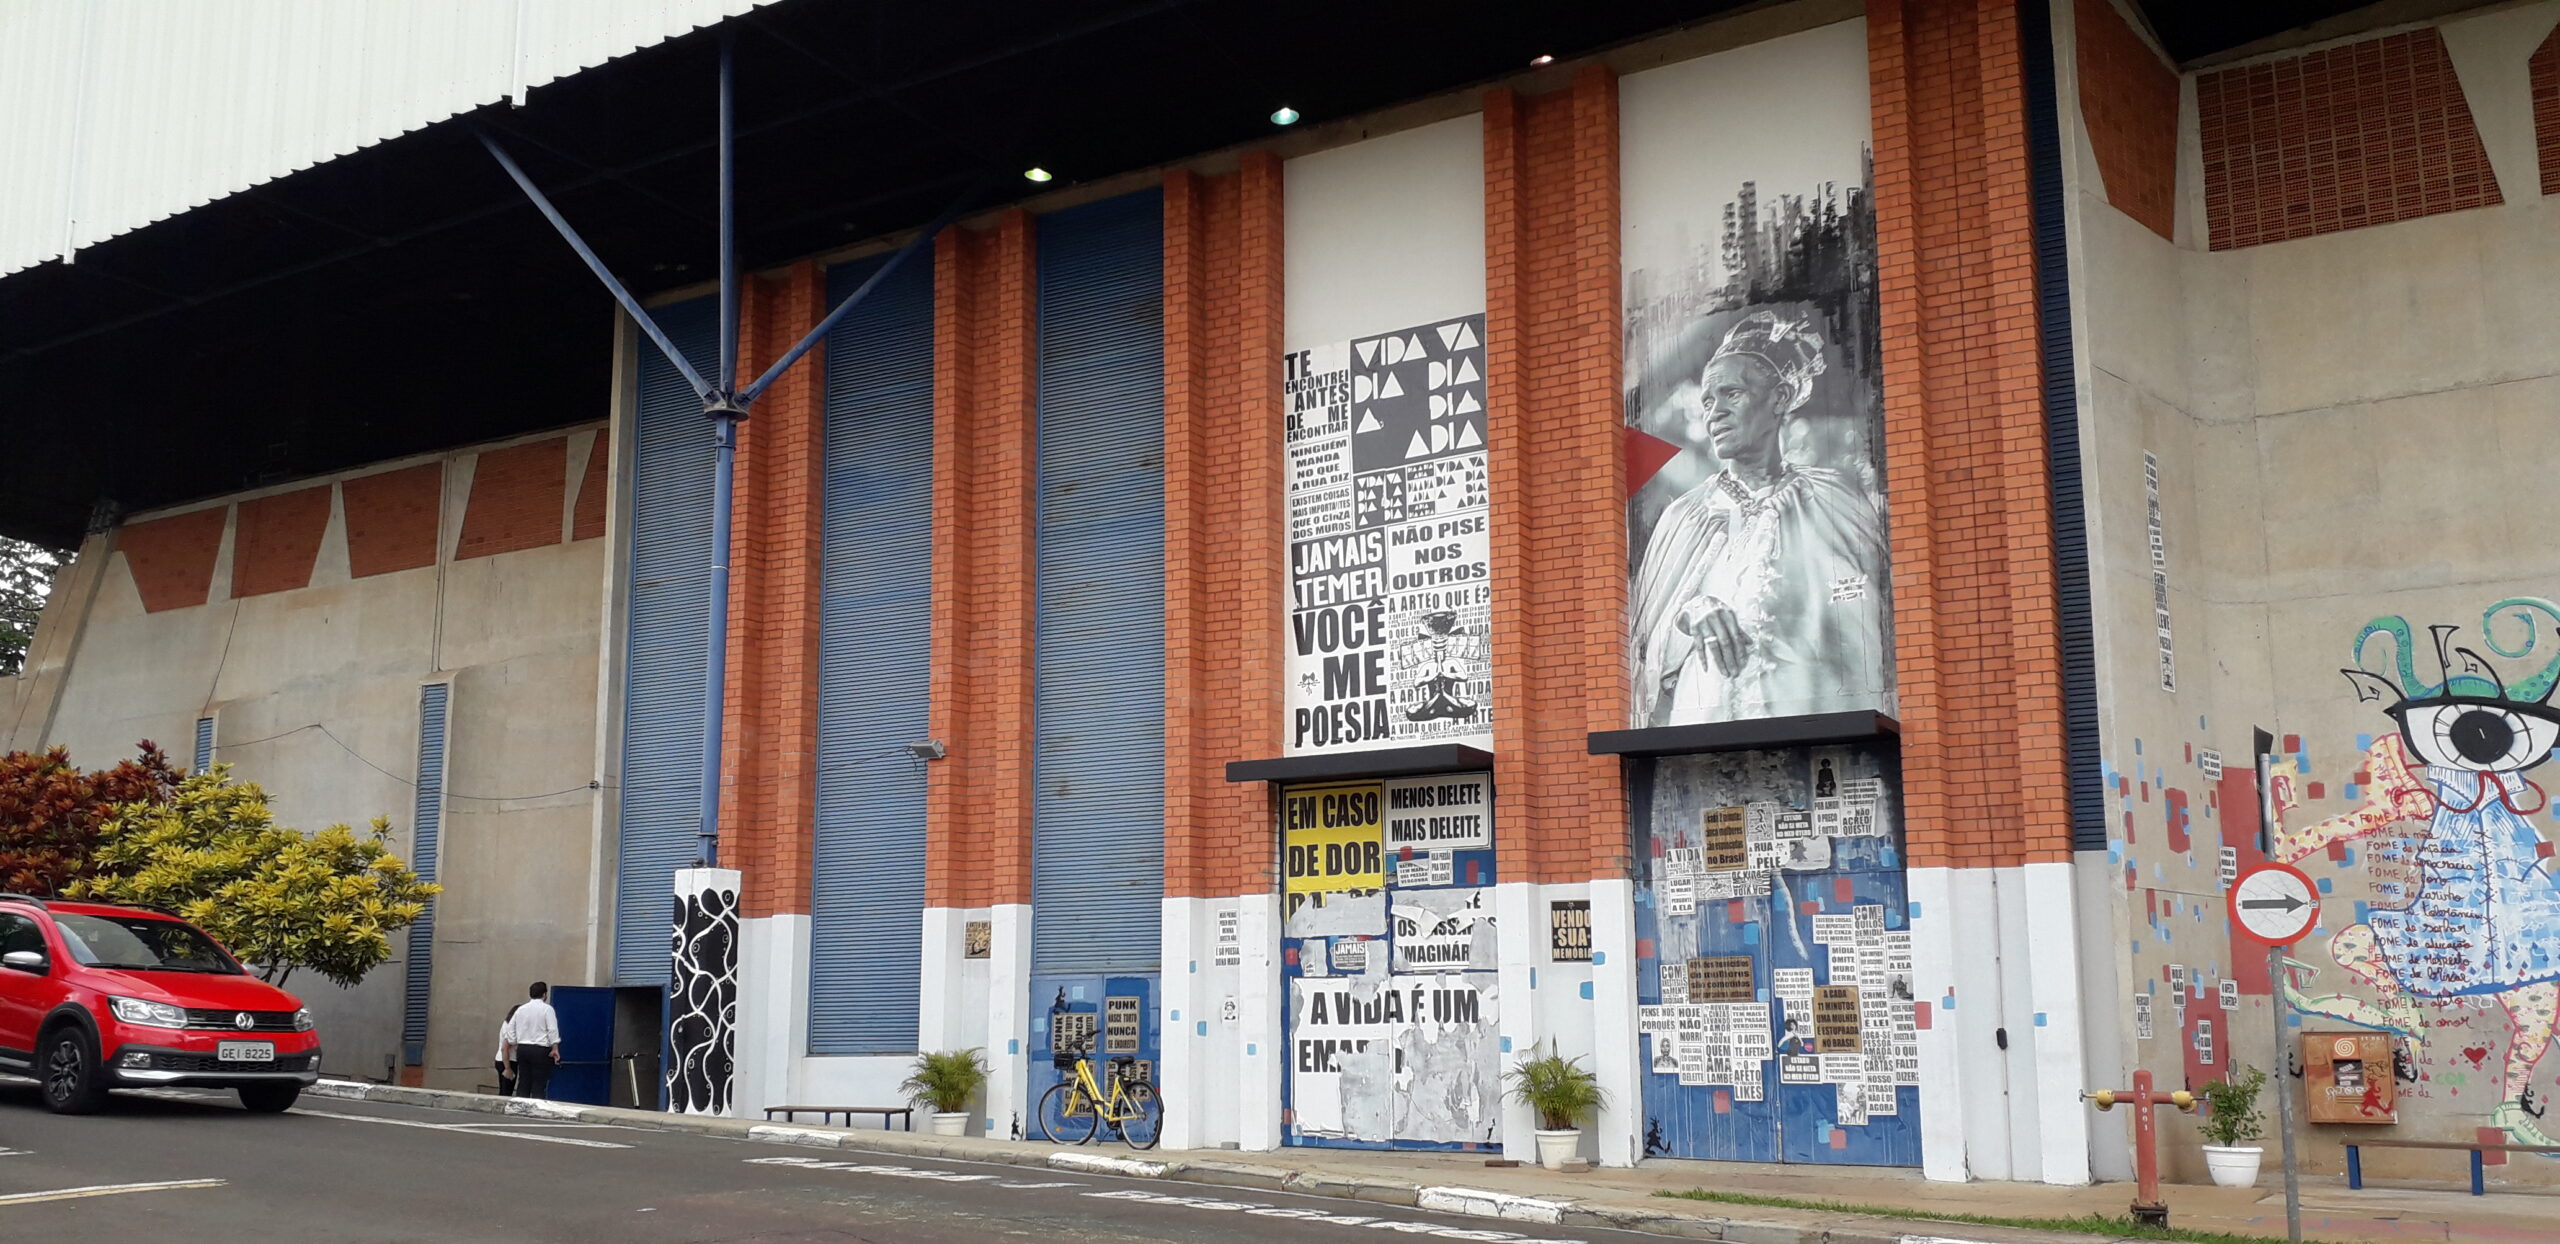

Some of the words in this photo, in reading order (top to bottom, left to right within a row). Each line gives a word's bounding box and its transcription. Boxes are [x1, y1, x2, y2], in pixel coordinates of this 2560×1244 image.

[1355, 333, 1427, 368] VIDA
[1285, 349, 1311, 381] TE
[1285, 369, 1348, 394] ENCONTREI
[1354, 371, 1405, 404] DIA
[1428, 355, 1481, 391] DIA
[1295, 382, 1349, 412] ANTES
[1429, 389, 1482, 420] DIA
[1287, 412, 1304, 431] DE
[1328, 403, 1348, 423] ME
[1287, 421, 1348, 443] ENCONTRAR
[1291, 439, 1347, 458] NINGUÉM
[1296, 452, 1340, 468] MANDA
[1436, 460, 1464, 472] VIDA
[1297, 469, 1313, 479] NO
[1317, 463, 1340, 475] QUE
[1303, 477, 1327, 489] RUA
[1330, 473, 1349, 483] DIZ
[1357, 475, 1384, 488] VIDA
[1292, 494, 1321, 507] EXISTEM
[1323, 488, 1349, 500] COISAS
[1292, 507, 1308, 518] MAIS
[1293, 517, 1311, 529] QUE
[1293, 528, 1313, 539] DOS
[1316, 521, 1351, 535] MUROS
[1391, 524, 1433, 547] NÃO
[1438, 516, 1485, 539] PISE
[1295, 530, 1383, 576] JAMAIS
[1414, 543, 1462, 565] NOS
[1393, 561, 1487, 591] OUTROS
[1296, 566, 1386, 609] TEMER
[1445, 589, 1469, 609] QUE
[1292, 599, 1386, 656] VOCÊ
[1323, 650, 1387, 701] ME
[1465, 680, 1491, 695] VIDA
[1400, 687, 1427, 703] ARTE
[1295, 698, 1390, 748] POESIA
[1391, 786, 1434, 809] MENOS
[1438, 783, 1481, 806] DELETE
[1288, 796, 1316, 830] EM
[1322, 791, 1379, 828] CASO
[2360, 813, 2391, 824] FOME
[1391, 818, 1426, 842] MAIS
[1430, 815, 1481, 840] DELEITE
[2364, 827, 2395, 839] FOME
[1754, 842, 1773, 852] RUA
[2366, 841, 2398, 851] FOME
[1288, 844, 1319, 877] DE
[1326, 841, 1380, 876] DOR
[1675, 848, 1700, 862] VIDA
[1707, 856, 1717, 864] no
[1719, 853, 1744, 864] Brasil
[2367, 854, 2399, 863] FOME
[1756, 856, 1781, 869] PELE
[2368, 867, 2400, 879] FOME
[2369, 883, 2400, 895] FOME
[2370, 901, 2398, 911] FOME
[1552, 909, 1591, 928] VENDO
[1854, 906, 1877, 920] COM
[1397, 919, 1416, 937] OS
[2371, 917, 2400, 928] FOME
[2405, 920, 2416, 932] de
[1557, 928, 1588, 946] SUA
[2374, 934, 2401, 946] FOME
[2407, 937, 2419, 948] de
[1335, 943, 1365, 954] JAMAIS
[2375, 953, 2404, 963] FOME
[2408, 953, 2419, 964] de
[2376, 968, 2405, 979] FOME
[2410, 967, 2422, 979] de
[1829, 989, 1847, 998] CADA
[1862, 991, 1886, 999] CRIME
[2376, 984, 2405, 993] FOME
[1108, 1000, 1136, 1009] PUNK
[1310, 992, 1328, 1024] A
[1334, 989, 1404, 1025] VIDA
[1411, 983, 1425, 1023] É
[1433, 989, 1479, 1023] UM
[1786, 1000, 1809, 1010] HOJE
[1825, 1001, 1855, 1010] MINUTOS
[2377, 996, 2408, 1009] FOME
[2411, 997, 2424, 1008] de
[1641, 1008, 1659, 1017] PENSE
[1662, 1008, 1675, 1017] NOS
[1679, 1008, 1700, 1017] HOJE
[1816, 1014, 1831, 1023] UMA
[1832, 1013, 1857, 1022] MULHER
[1642, 1019, 1675, 1030] PORQUÊS
[1680, 1018, 1701, 1029] NÃO
[2383, 1016, 2411, 1028] FOME
[2419, 1014, 2431, 1028] de
[1054, 1017, 1063, 1050] PUNK
[1107, 1026, 1136, 1036] NUNCA
[1822, 1026, 1859, 1035] ESTUPRADA
[1744, 1034, 1765, 1044] AFETO
[1822, 1039, 1831, 1047] NO
[1832, 1038, 1855, 1047] BRASIL
[222, 1049, 240, 1059] GEI
[245, 1049, 271, 1059] 8225
[1706, 1045, 1731, 1058] QUEM
[1735, 1047, 1743, 1056] TE
[1744, 1047, 1769, 1057] AFETA?
[1707, 1058, 1732, 1072] AMA
[1864, 1060, 1893, 1072] CARTAS
[1707, 1073, 1733, 1083] LAMBE
[1734, 1070, 1761, 1081] AFETO
[1735, 1086, 1762, 1099] LIKES
[1868, 1094, 1880, 1102] NÃO
